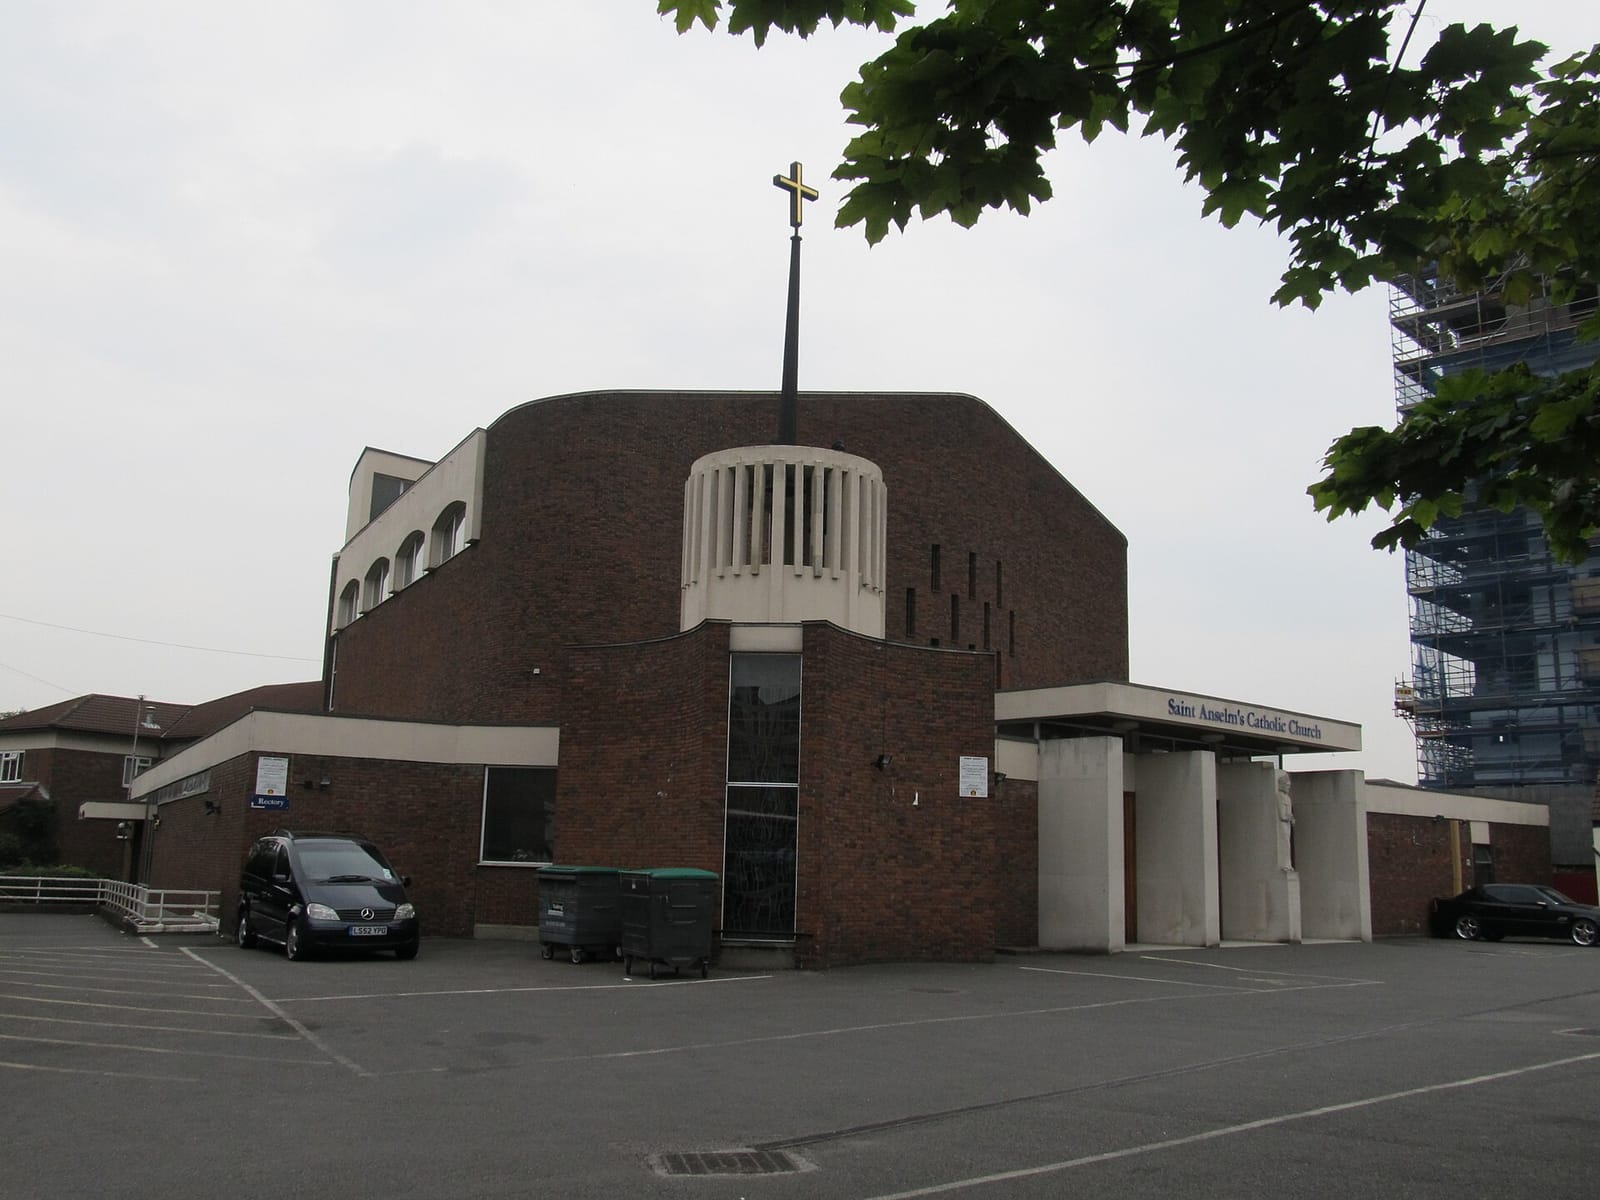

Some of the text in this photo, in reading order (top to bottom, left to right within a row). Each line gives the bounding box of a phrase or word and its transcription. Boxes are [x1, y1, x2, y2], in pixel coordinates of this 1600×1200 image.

[1168, 698, 1321, 739] Saint Anselm's Catholic Church
[257, 797, 285, 808] Rectory
